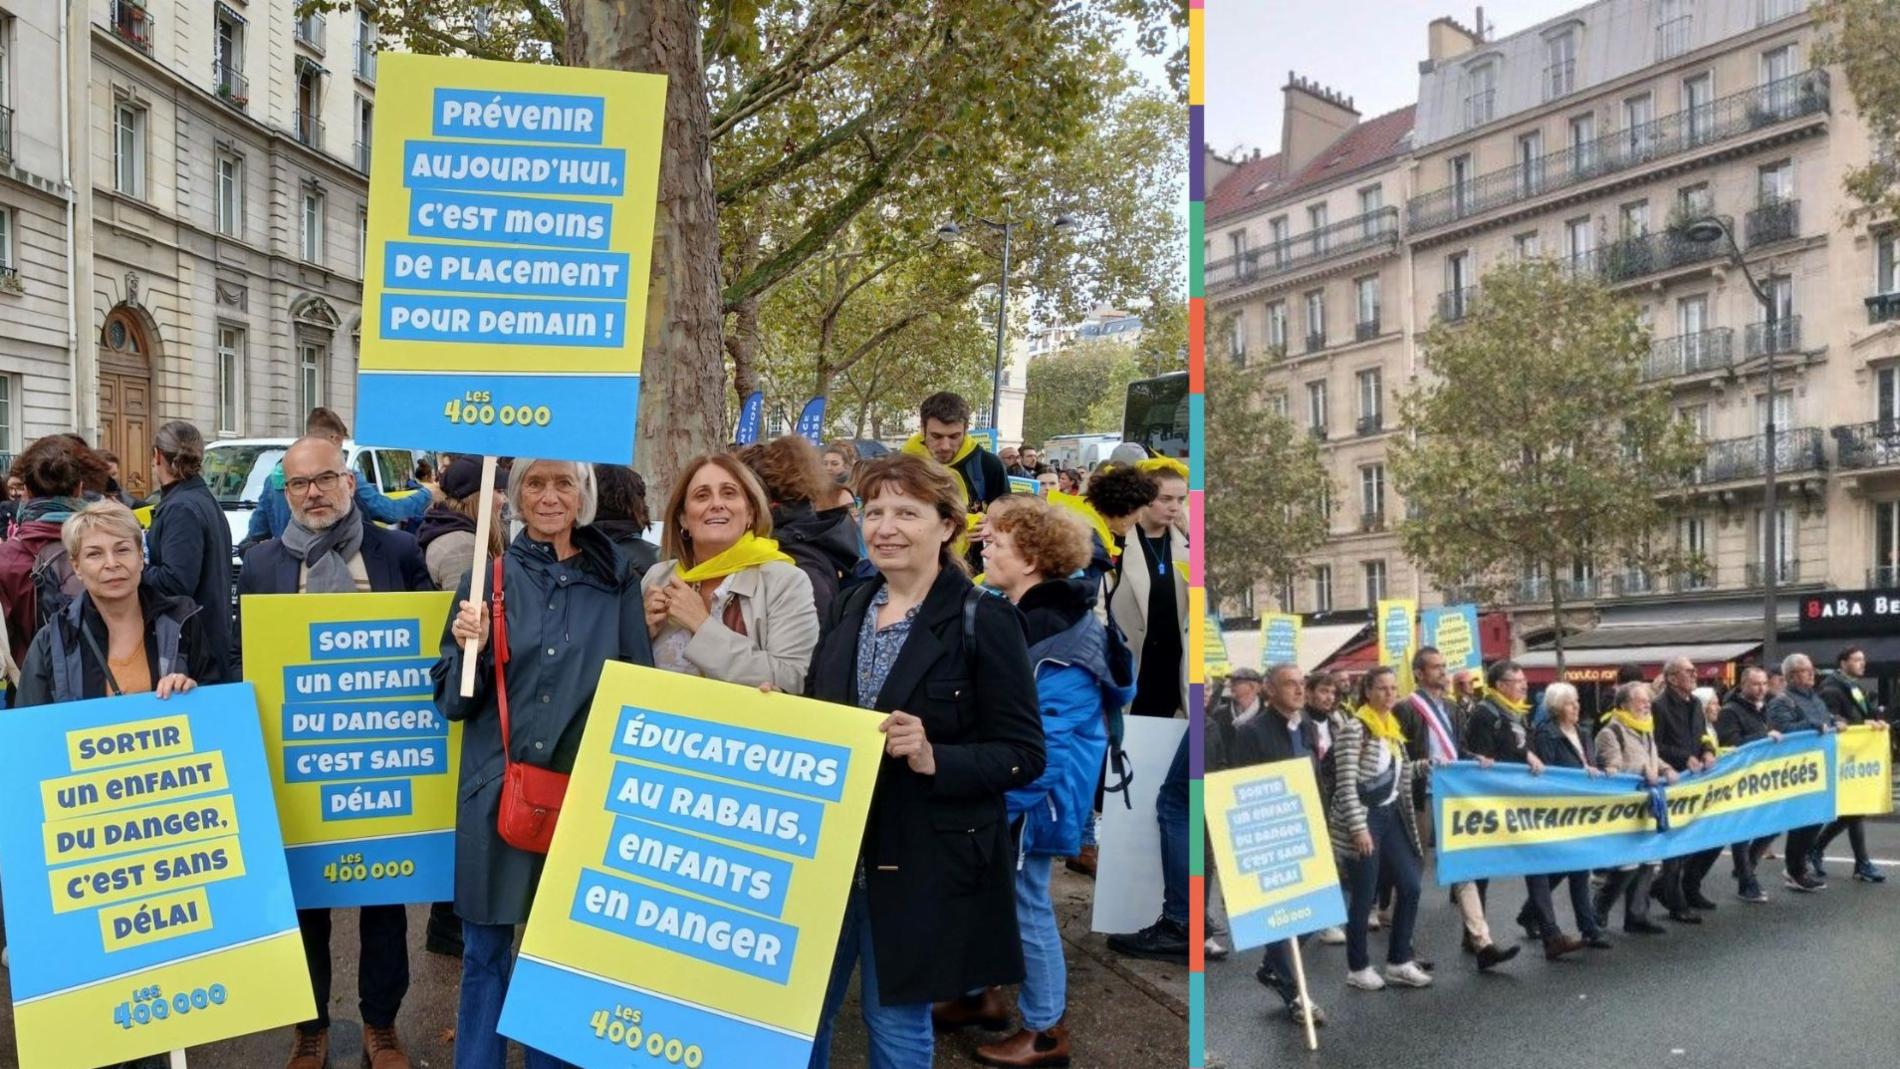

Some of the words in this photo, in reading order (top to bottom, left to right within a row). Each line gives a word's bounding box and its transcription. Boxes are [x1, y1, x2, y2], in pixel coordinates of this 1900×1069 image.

[505, 210, 604, 240] MOINS
[395, 254, 433, 278] DE
[441, 257, 619, 287] PLACEMENT
[391, 307, 470, 332] POUR
[479, 310, 597, 337] DEMAIN
[604, 313, 614, 339] !
[1808, 598, 1862, 618] BABA
[319, 628, 410, 652] SORTIR
[338, 668, 433, 692] ENFANT
[292, 712, 325, 732] DU
[79, 726, 181, 759] SORTIR
[370, 748, 434, 769] SANS
[623, 714, 839, 787] ÉDUCATEURS
[106, 763, 213, 800] ENFANT
[331, 786, 401, 812] DÉLAI
[1505, 804, 1606, 833] ENFANTS
[1607, 794, 1700, 822] DOINT
[669, 792, 807, 846] RABAIS,
[57, 828, 95, 854] DU
[155, 848, 228, 882] SANS
[618, 832, 772, 900] ENFANTS
[114, 902, 198, 939] DÉLAI
[636, 900, 782, 966] DANGER
